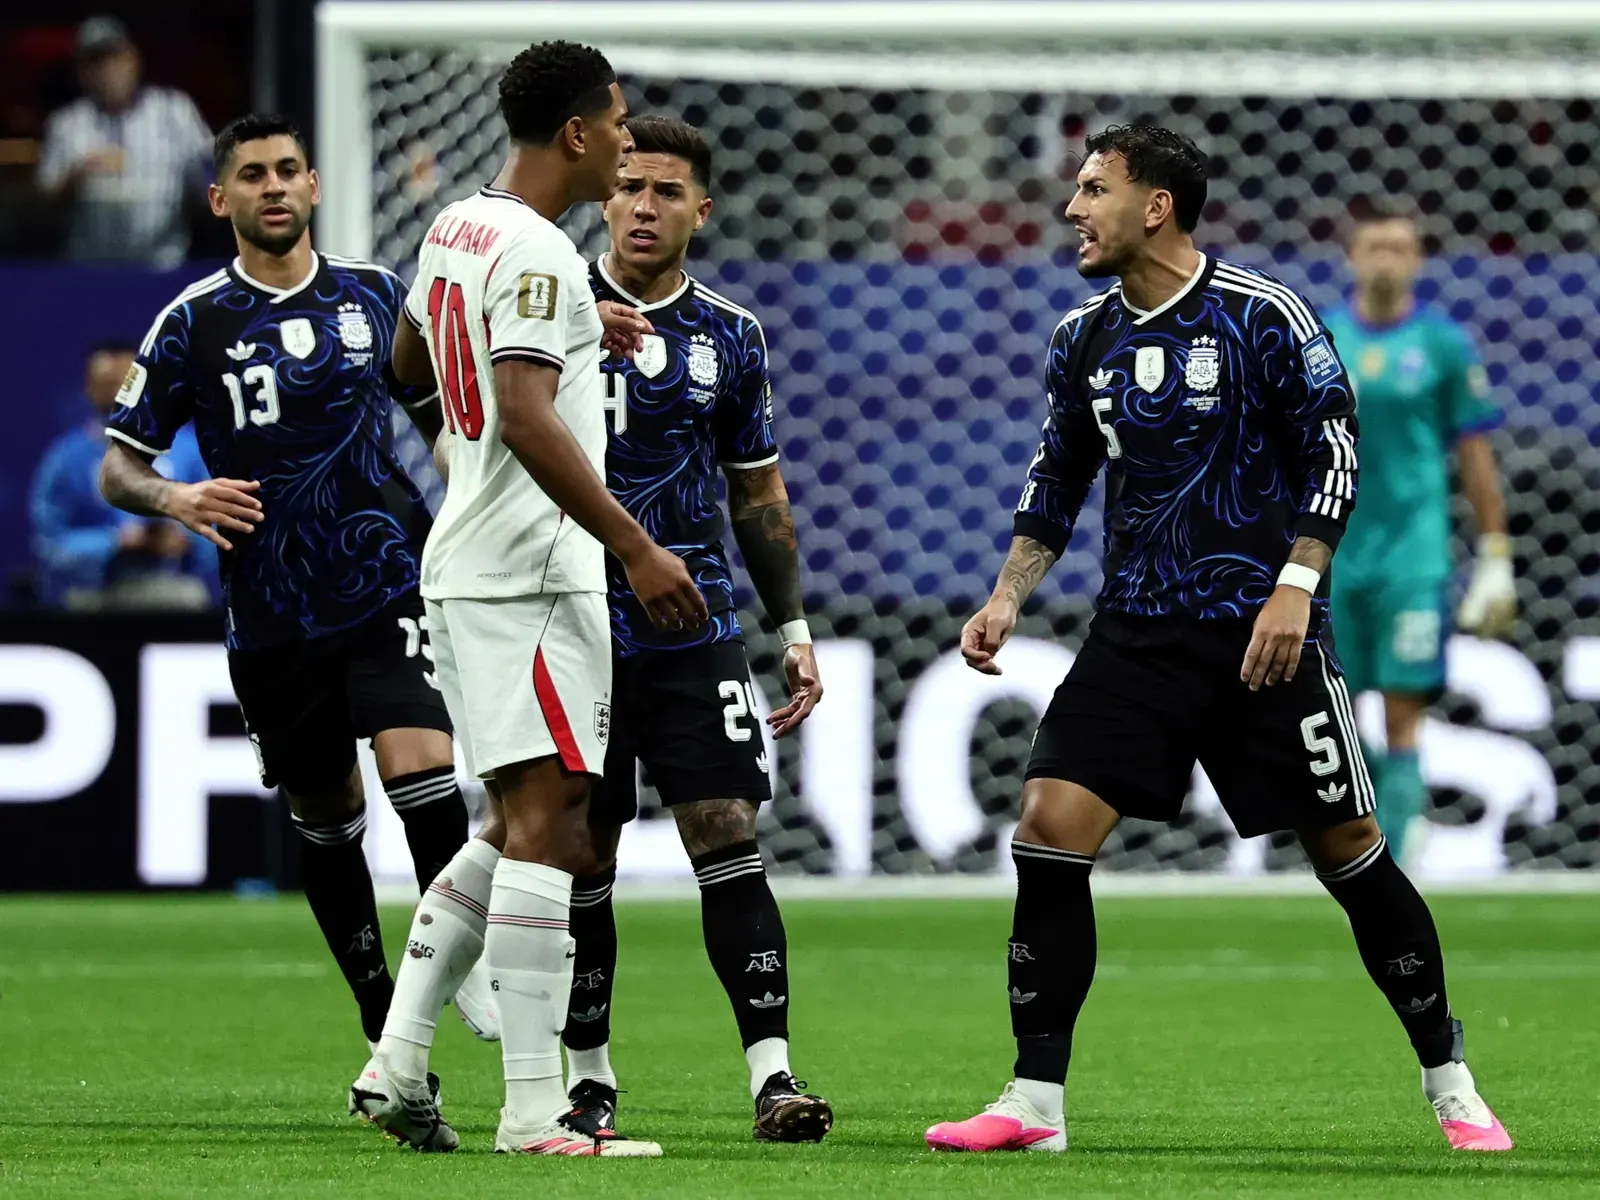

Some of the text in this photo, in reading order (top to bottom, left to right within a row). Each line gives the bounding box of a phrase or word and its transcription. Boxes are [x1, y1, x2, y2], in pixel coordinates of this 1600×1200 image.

[427, 276, 484, 441] 10
[222, 364, 280, 430] 13
[600, 372, 628, 436] 4
[1091, 397, 1123, 459] 5
[1300, 710, 1342, 777] 5
